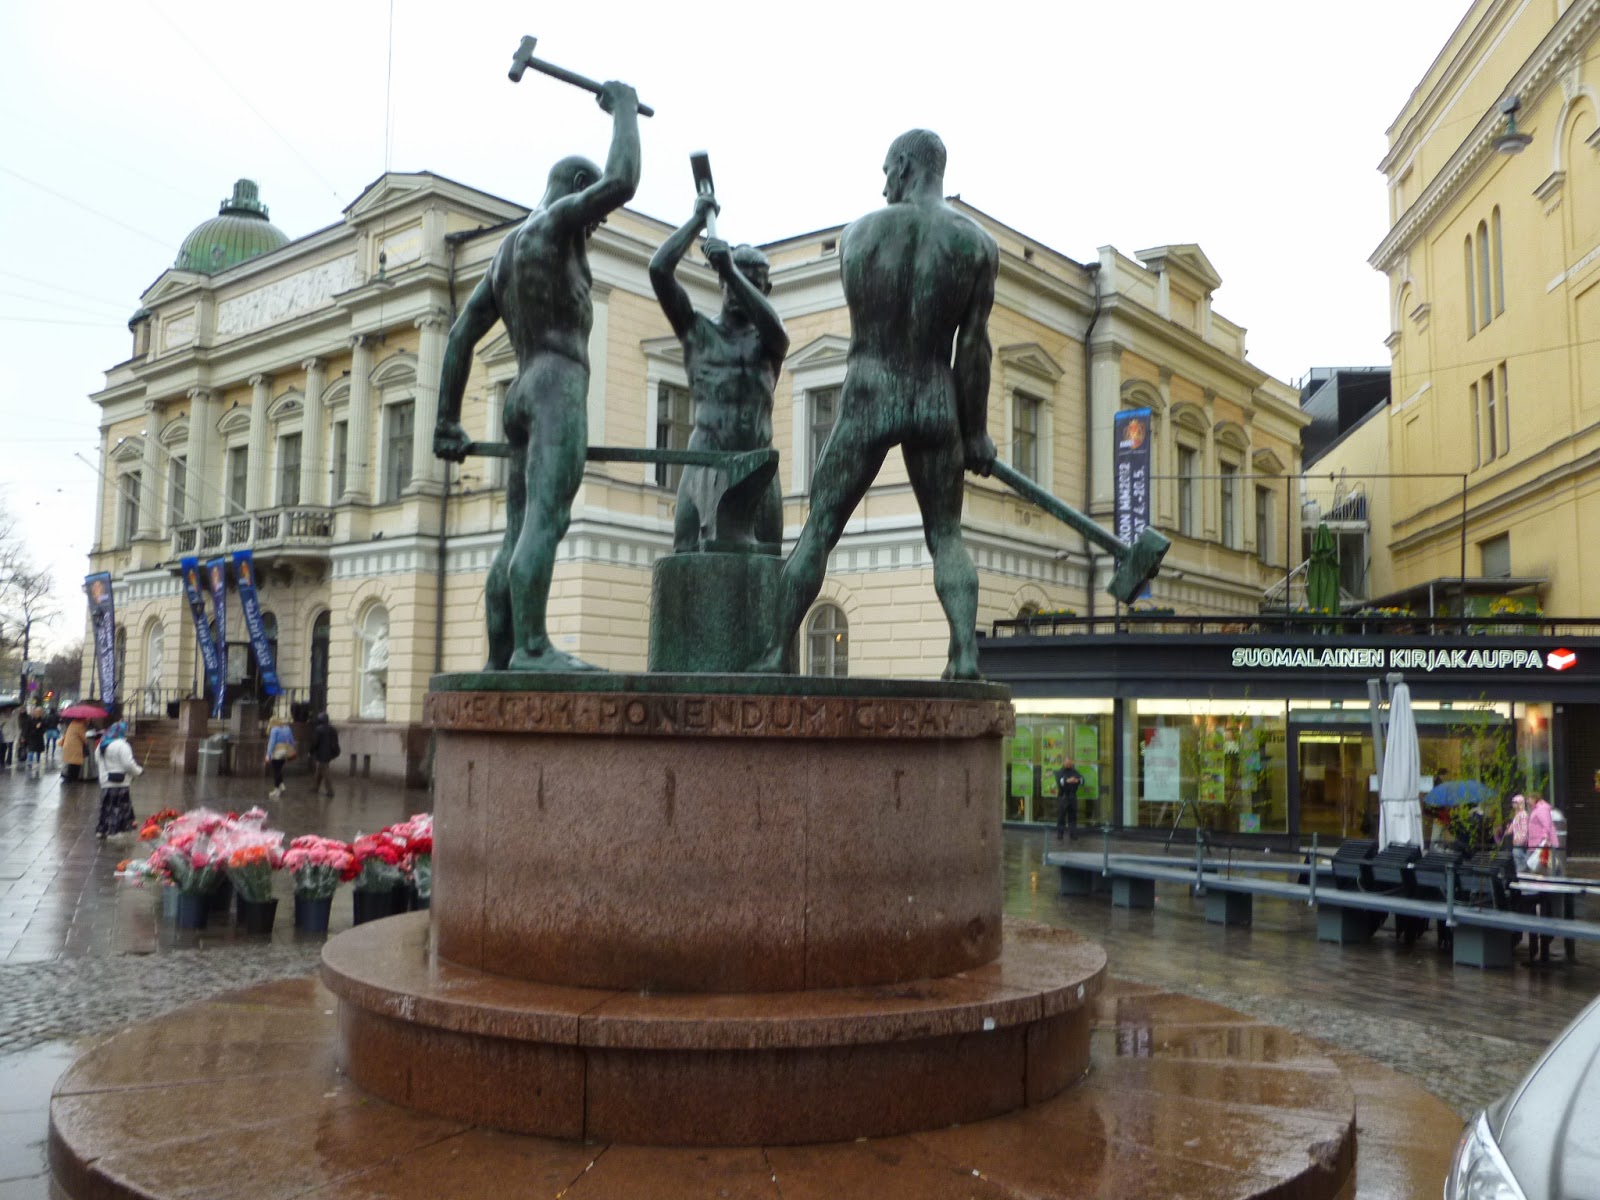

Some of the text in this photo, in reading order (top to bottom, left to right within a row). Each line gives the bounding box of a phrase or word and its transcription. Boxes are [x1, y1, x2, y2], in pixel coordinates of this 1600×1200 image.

[1231, 647, 1543, 671] SUOMALAINEN KIRJAKAUPPA
[599, 698, 826, 732] PONENDUM
[856, 702, 980, 733] CURAVIT
